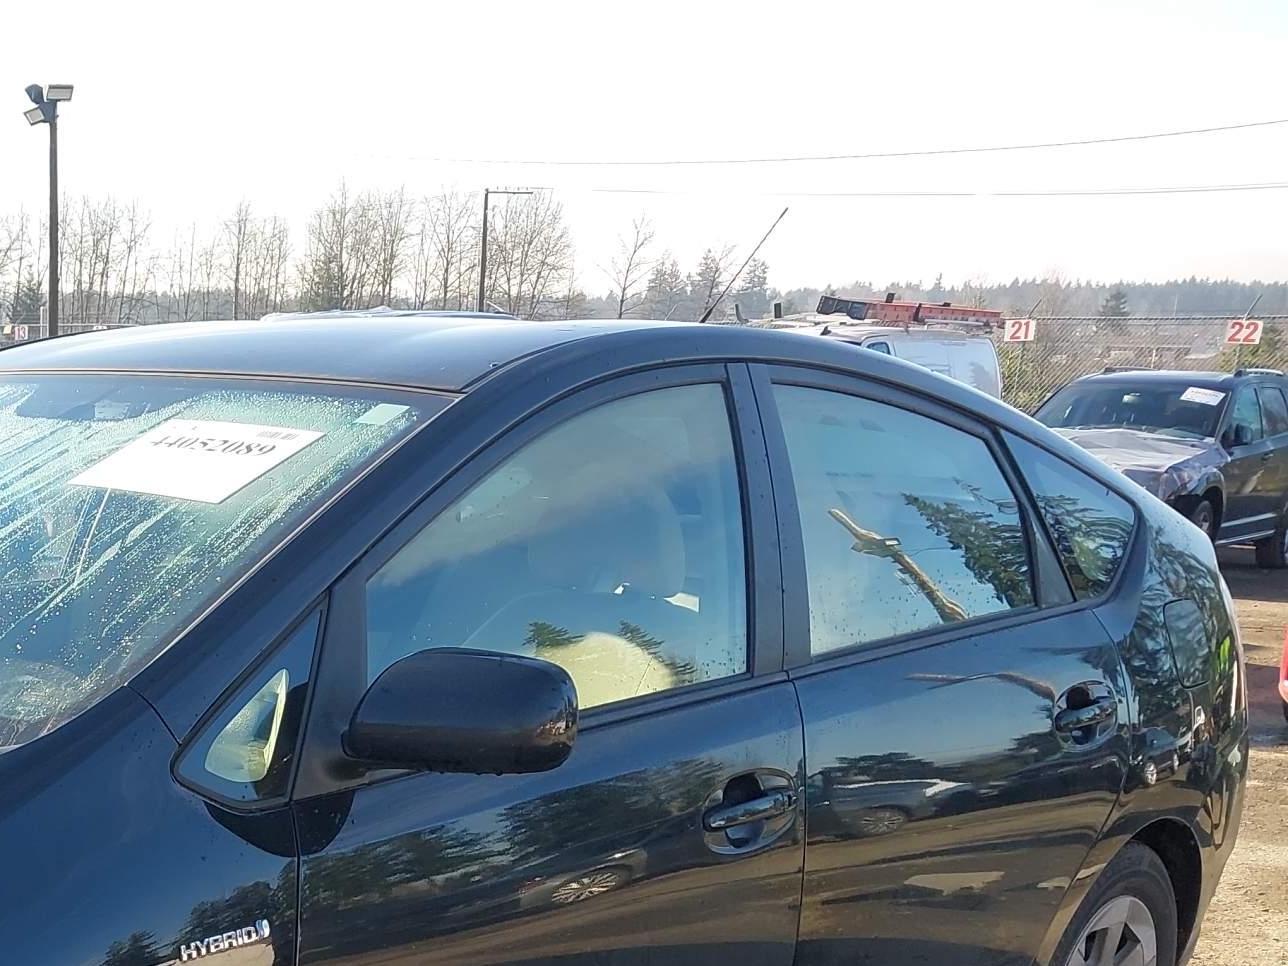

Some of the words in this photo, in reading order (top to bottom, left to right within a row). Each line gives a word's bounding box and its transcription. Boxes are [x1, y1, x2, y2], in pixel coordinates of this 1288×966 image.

[1009, 320, 1030, 340] 21
[1227, 321, 1261, 343] 22
[150, 435, 277, 456] 44052089
[180, 926, 259, 961] HYBRID
